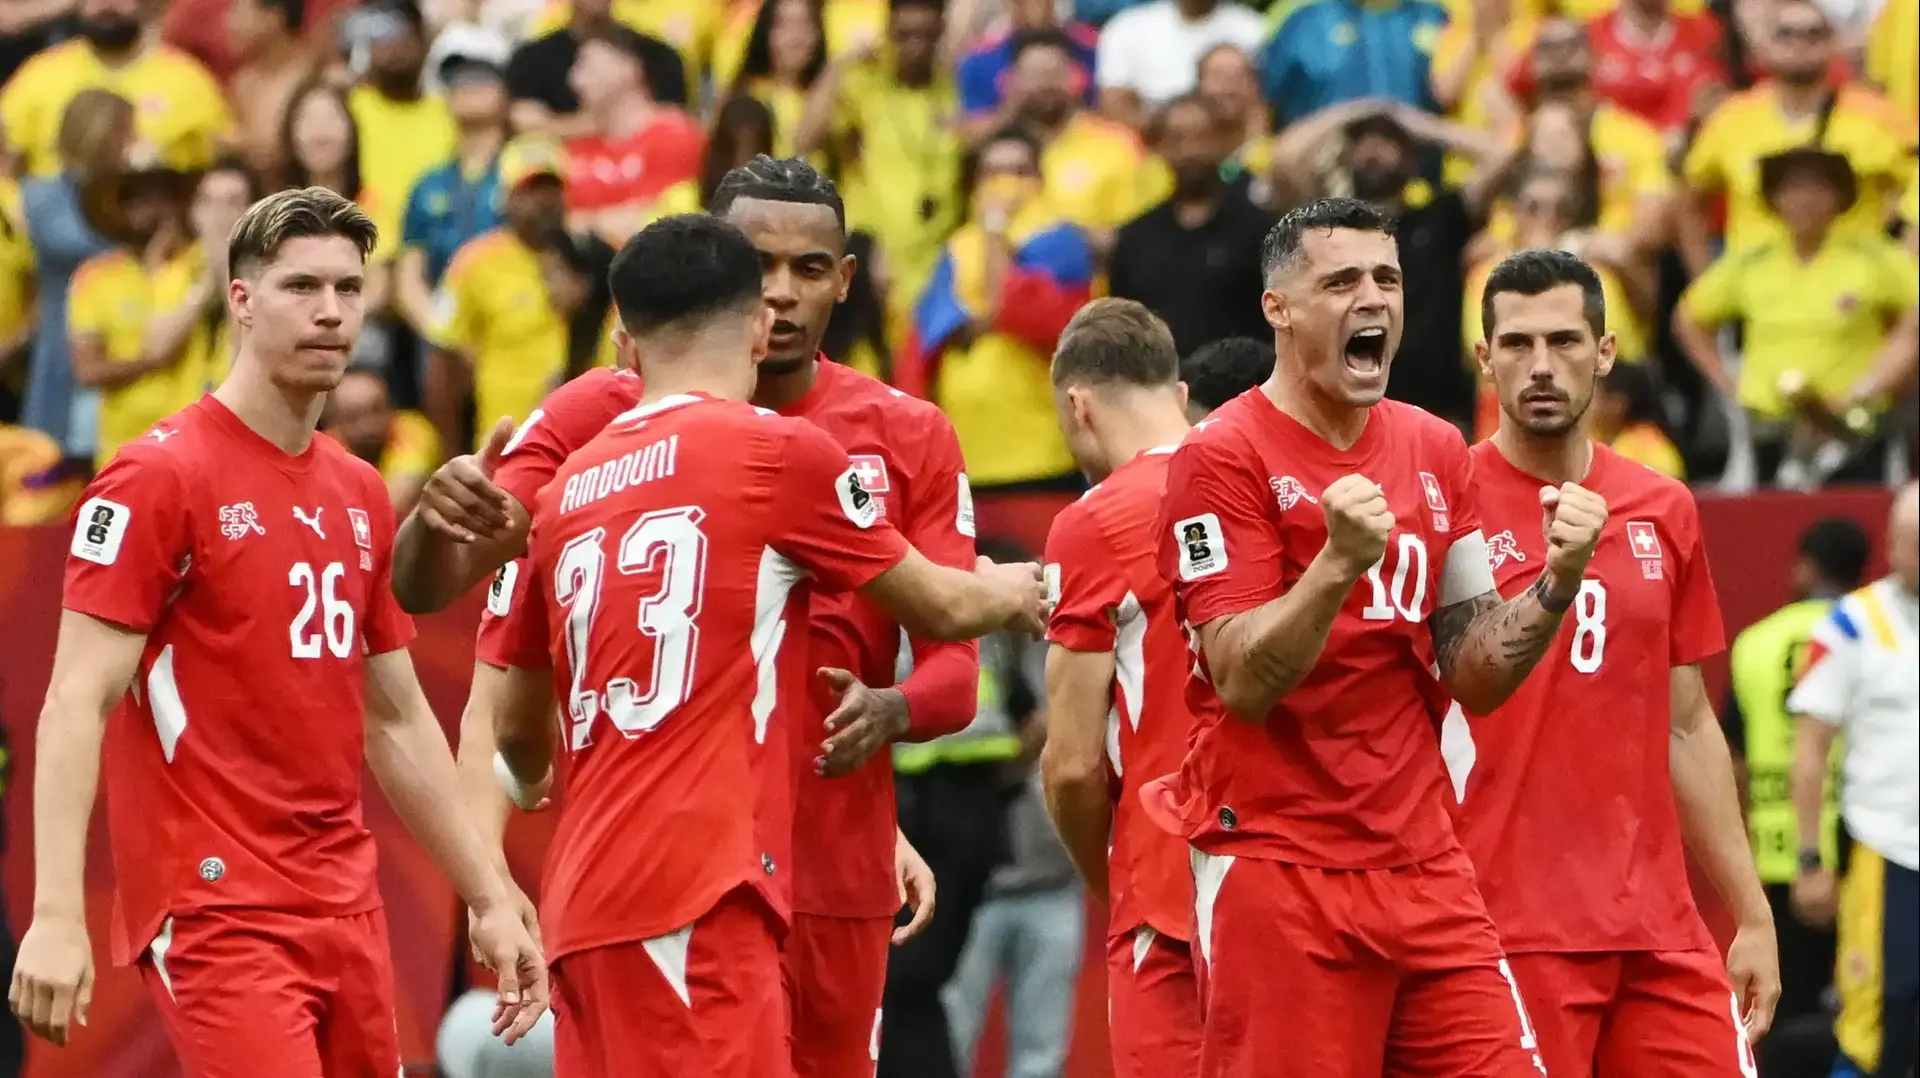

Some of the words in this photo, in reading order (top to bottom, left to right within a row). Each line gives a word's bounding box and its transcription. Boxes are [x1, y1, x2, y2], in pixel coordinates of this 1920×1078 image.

[560, 434, 679, 515] AMDOUNI
[288, 561, 355, 659] 26
[1362, 533, 1428, 623] 10
[554, 505, 708, 751] 23
[1570, 579, 1607, 674] 8
